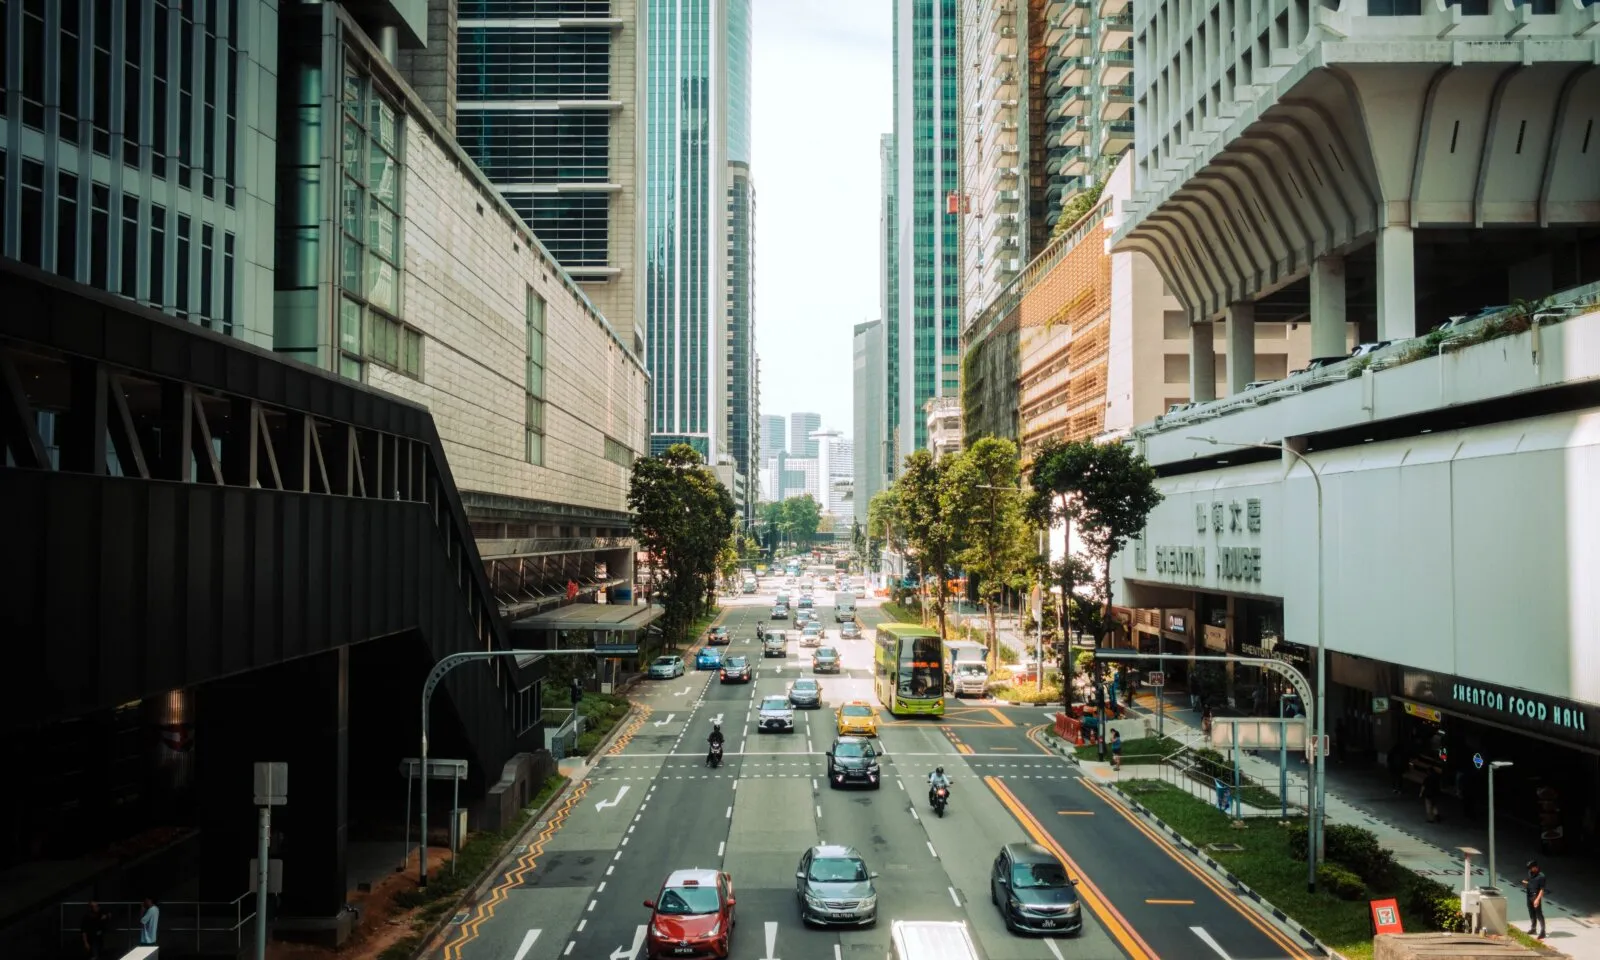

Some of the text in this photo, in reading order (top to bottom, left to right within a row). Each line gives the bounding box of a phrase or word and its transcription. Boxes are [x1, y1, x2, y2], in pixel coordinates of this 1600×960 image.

[1453, 683, 1503, 711] SHENTON
[1509, 696, 1547, 721] FOOD
[1553, 705, 1585, 731] HALL
